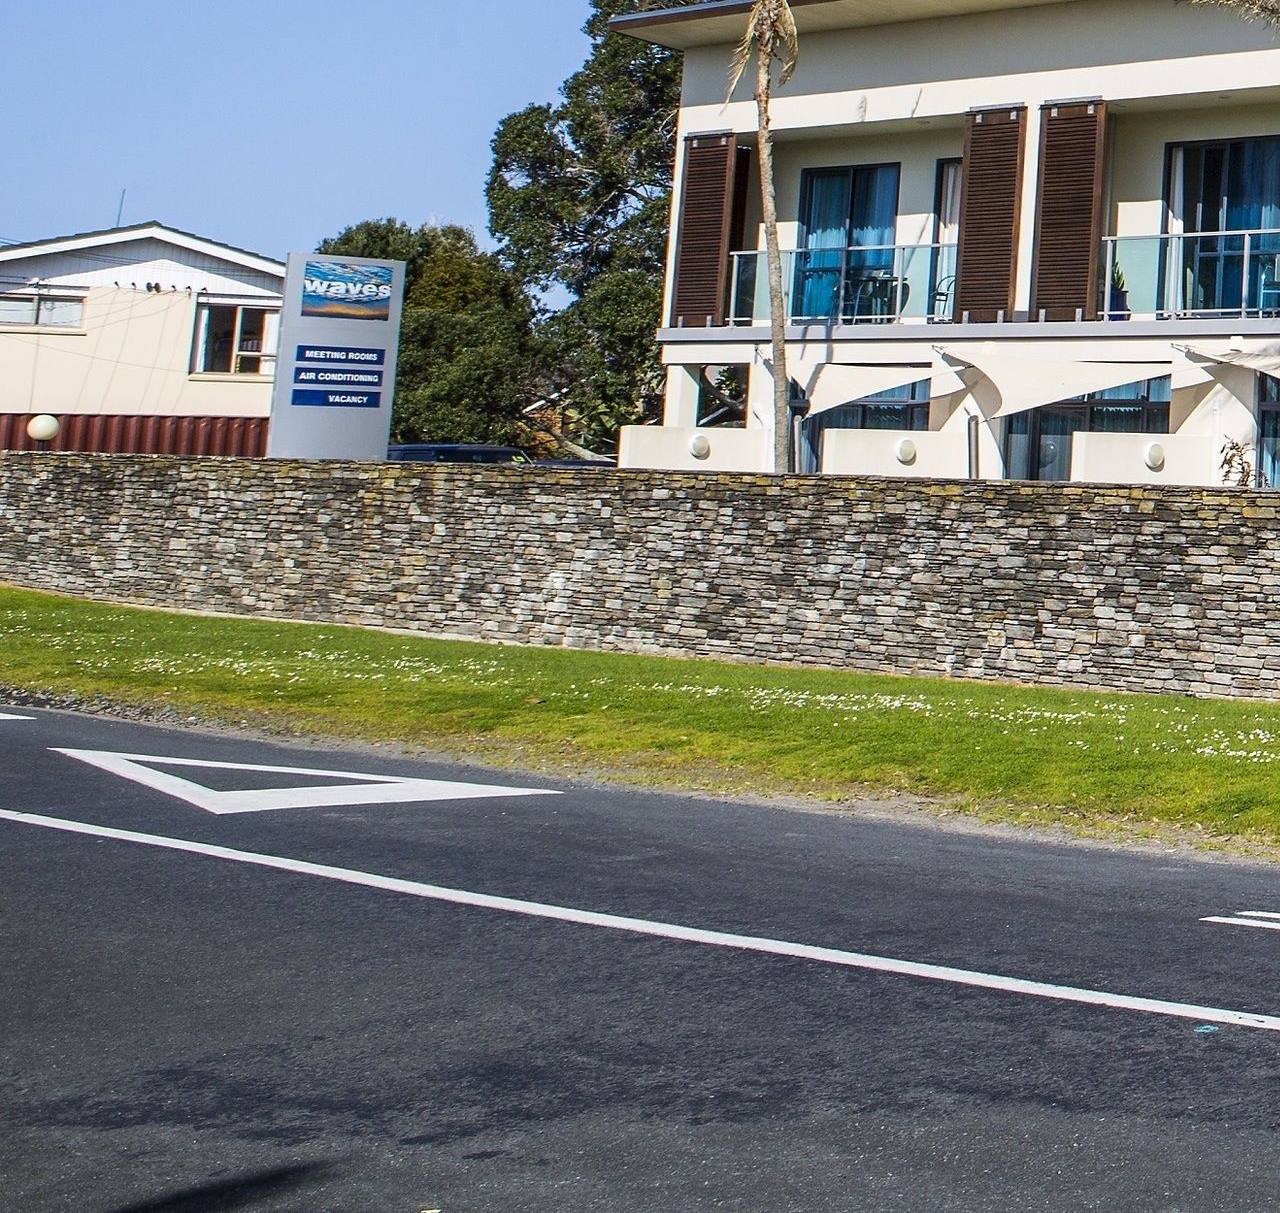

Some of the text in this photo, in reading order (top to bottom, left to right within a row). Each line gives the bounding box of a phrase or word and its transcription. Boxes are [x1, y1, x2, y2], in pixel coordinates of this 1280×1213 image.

[304, 279, 392, 297] waves
[305, 350, 378, 361] MEETING ROOMS
[299, 372, 379, 382] AIR CONDITIONING
[328, 395, 369, 404] VACANCY
